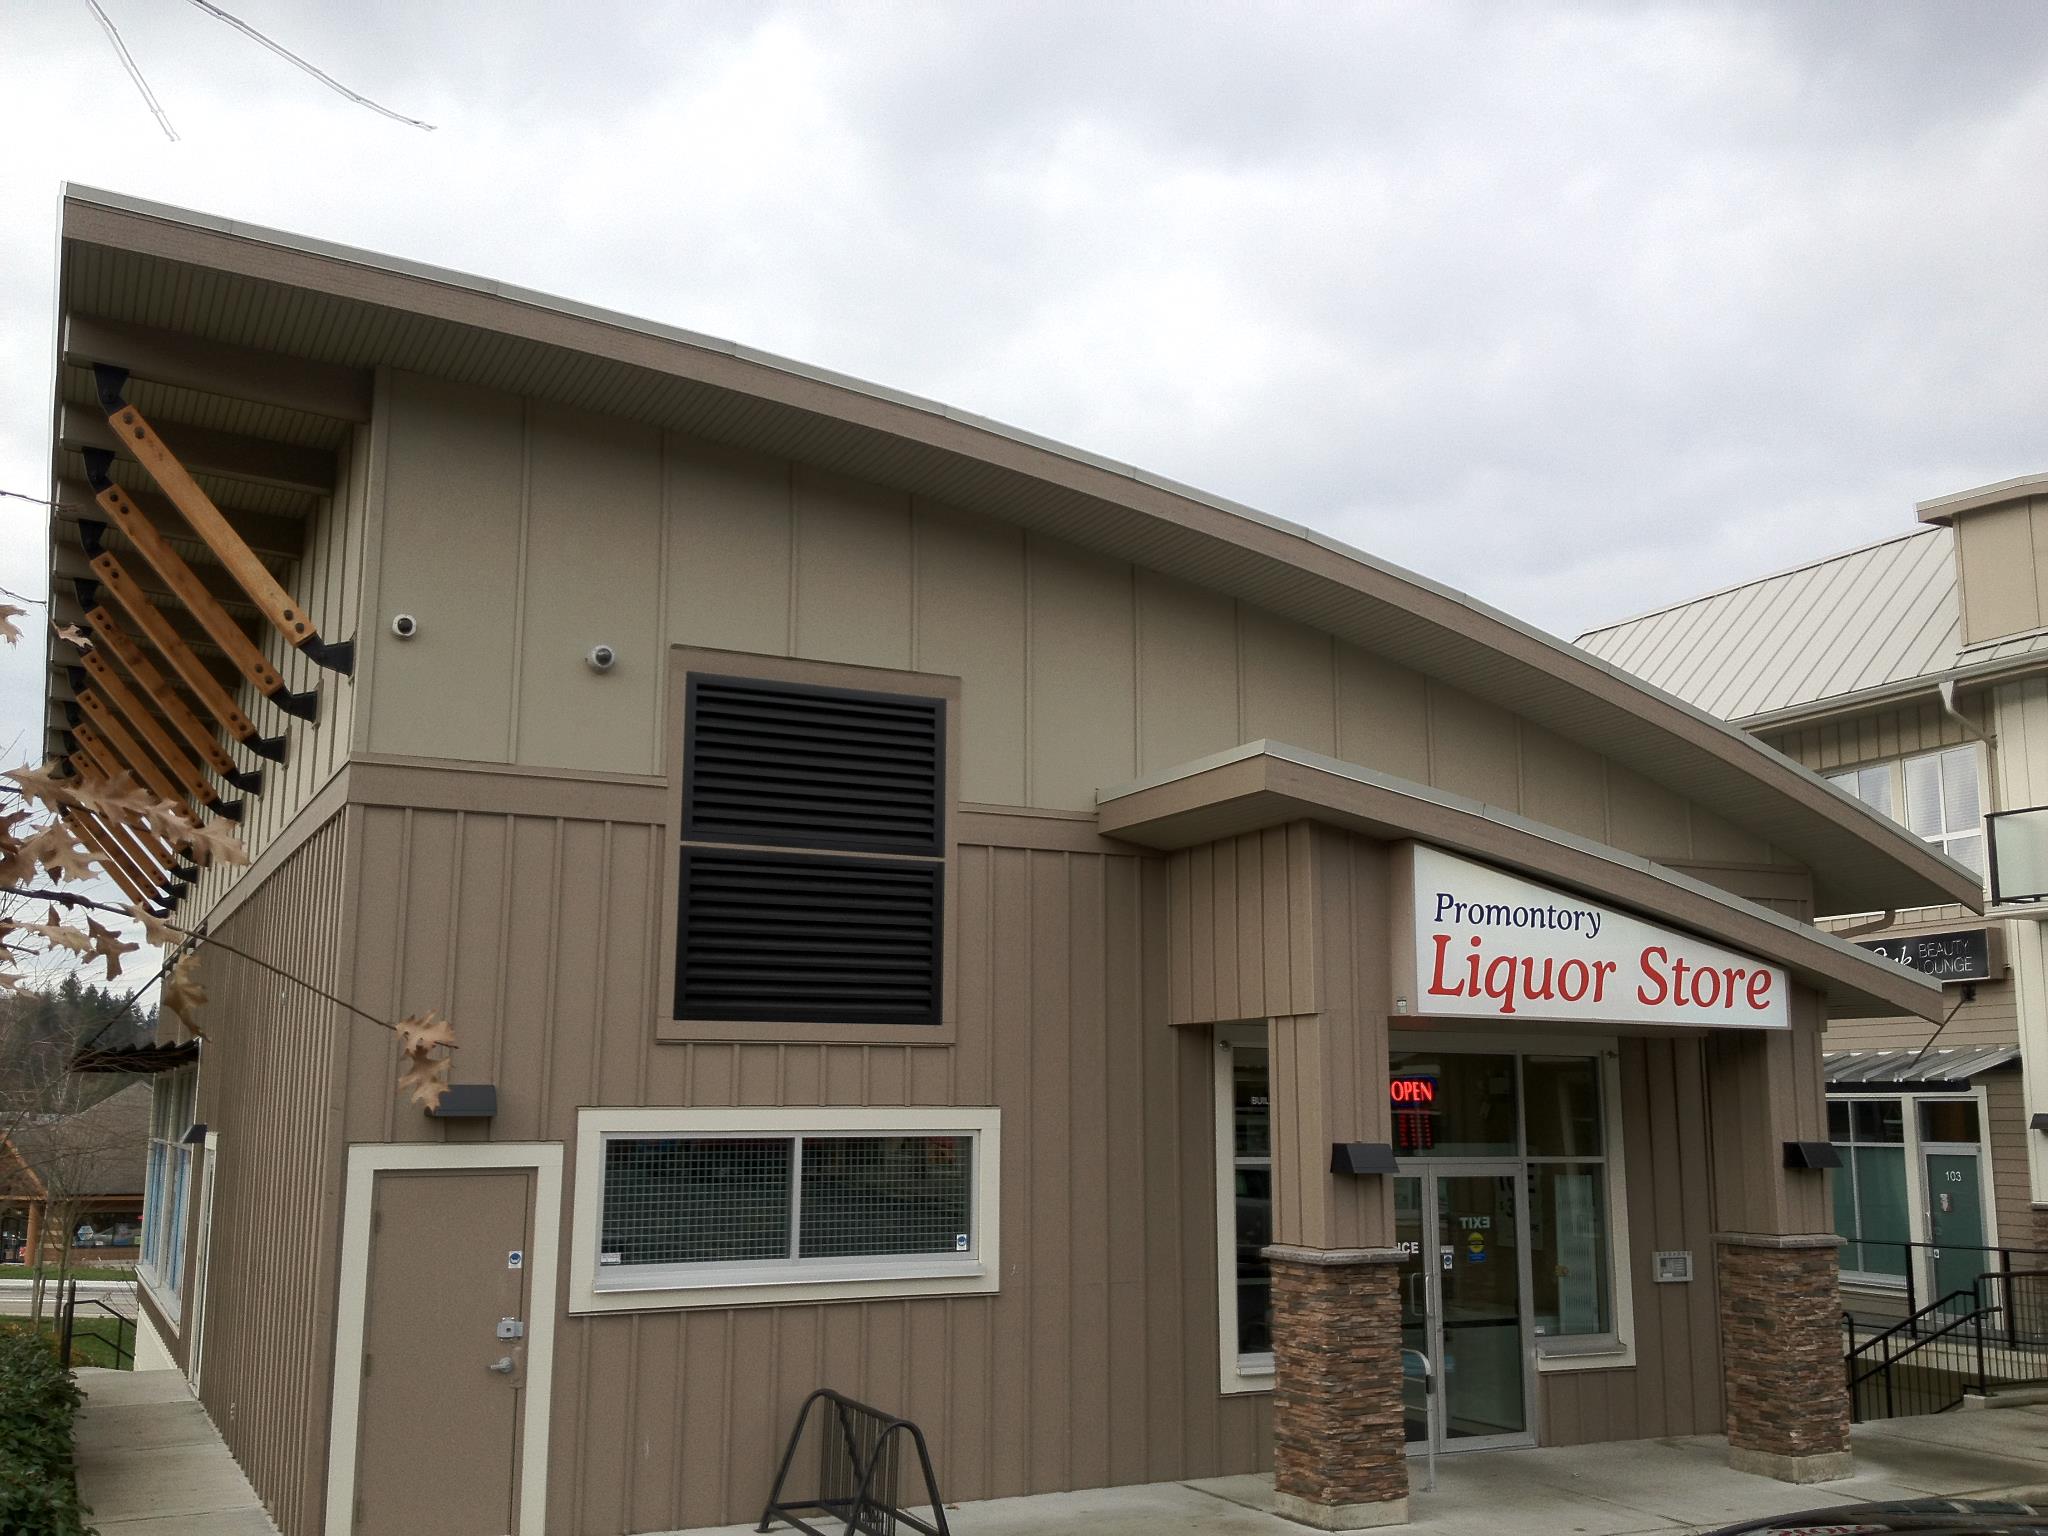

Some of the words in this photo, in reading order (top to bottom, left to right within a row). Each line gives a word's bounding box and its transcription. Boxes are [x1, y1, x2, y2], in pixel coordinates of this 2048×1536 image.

[1434, 892, 1601, 939] Promontory
[1918, 939, 1969, 958] BEAUTY
[1427, 934, 1617, 1014] Liquor
[1637, 946, 1772, 1010] Store
[1391, 1081, 1433, 1102] OPEN
[1945, 1170, 1962, 1182] 103
